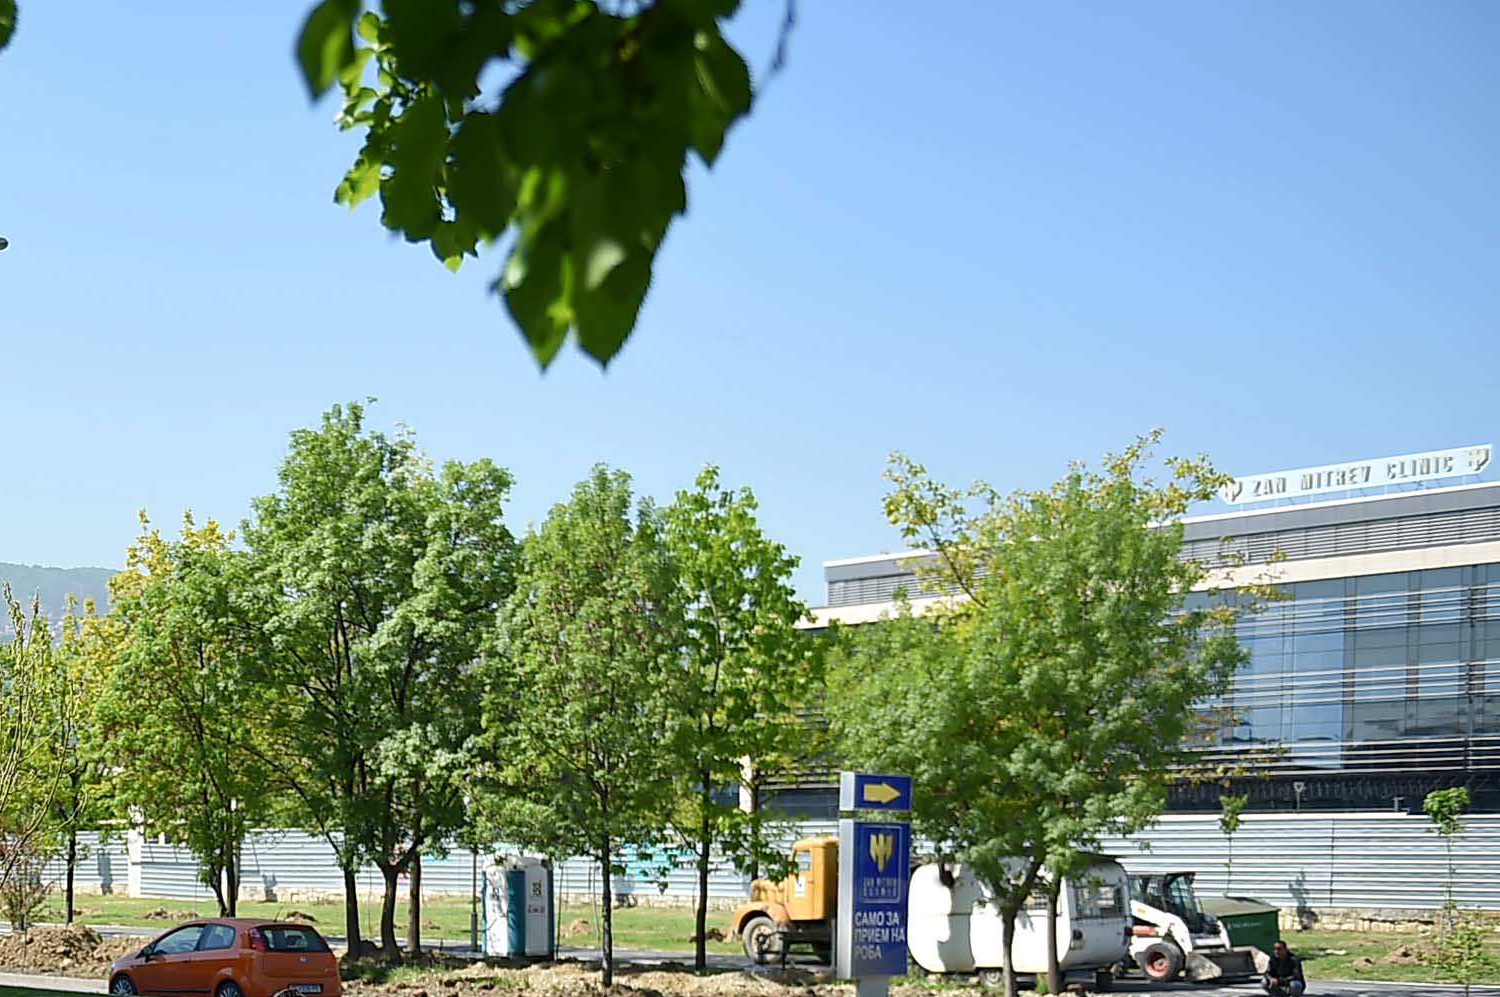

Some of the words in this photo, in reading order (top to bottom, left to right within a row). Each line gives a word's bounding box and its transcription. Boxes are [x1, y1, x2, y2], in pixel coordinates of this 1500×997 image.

[1252, 478, 1286, 497] ZAN
[1300, 466, 1372, 490] MITREV
[1386, 455, 1454, 480] CLINIC
[855, 911, 884, 926] САМО
[885, 911, 900, 926] ЗА
[855, 927, 889, 942] ПРИЕМ
[891, 927, 905, 942] НА
[855, 944, 882, 960] РОБА
